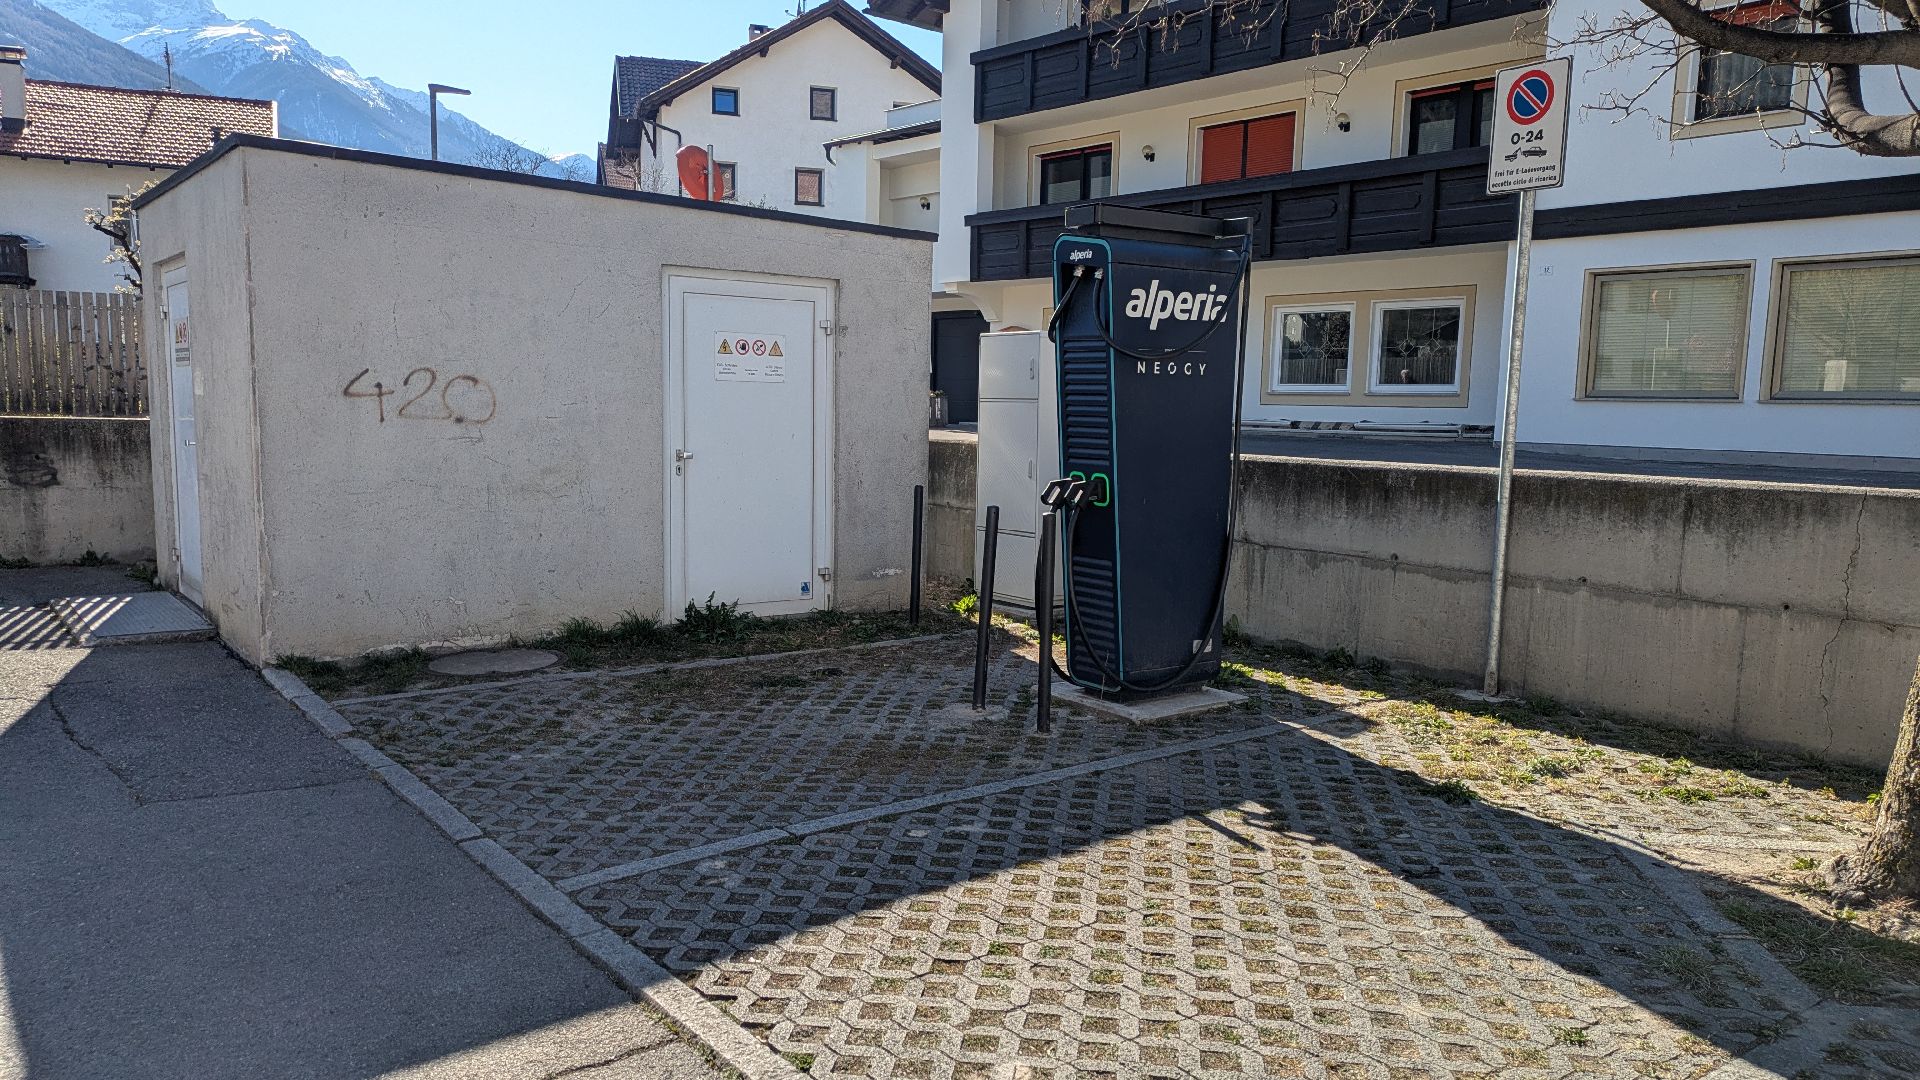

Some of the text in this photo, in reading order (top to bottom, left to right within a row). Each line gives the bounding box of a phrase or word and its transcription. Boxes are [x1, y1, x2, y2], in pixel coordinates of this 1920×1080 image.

[1511, 129, 1544, 145] 0-24
[1528, 176, 1534, 184] di
[1070, 249, 1093, 261] alperia
[1125, 279, 1228, 331] alperia
[1137, 361, 1207, 376] NEOGY
[343, 367, 497, 425] 420
